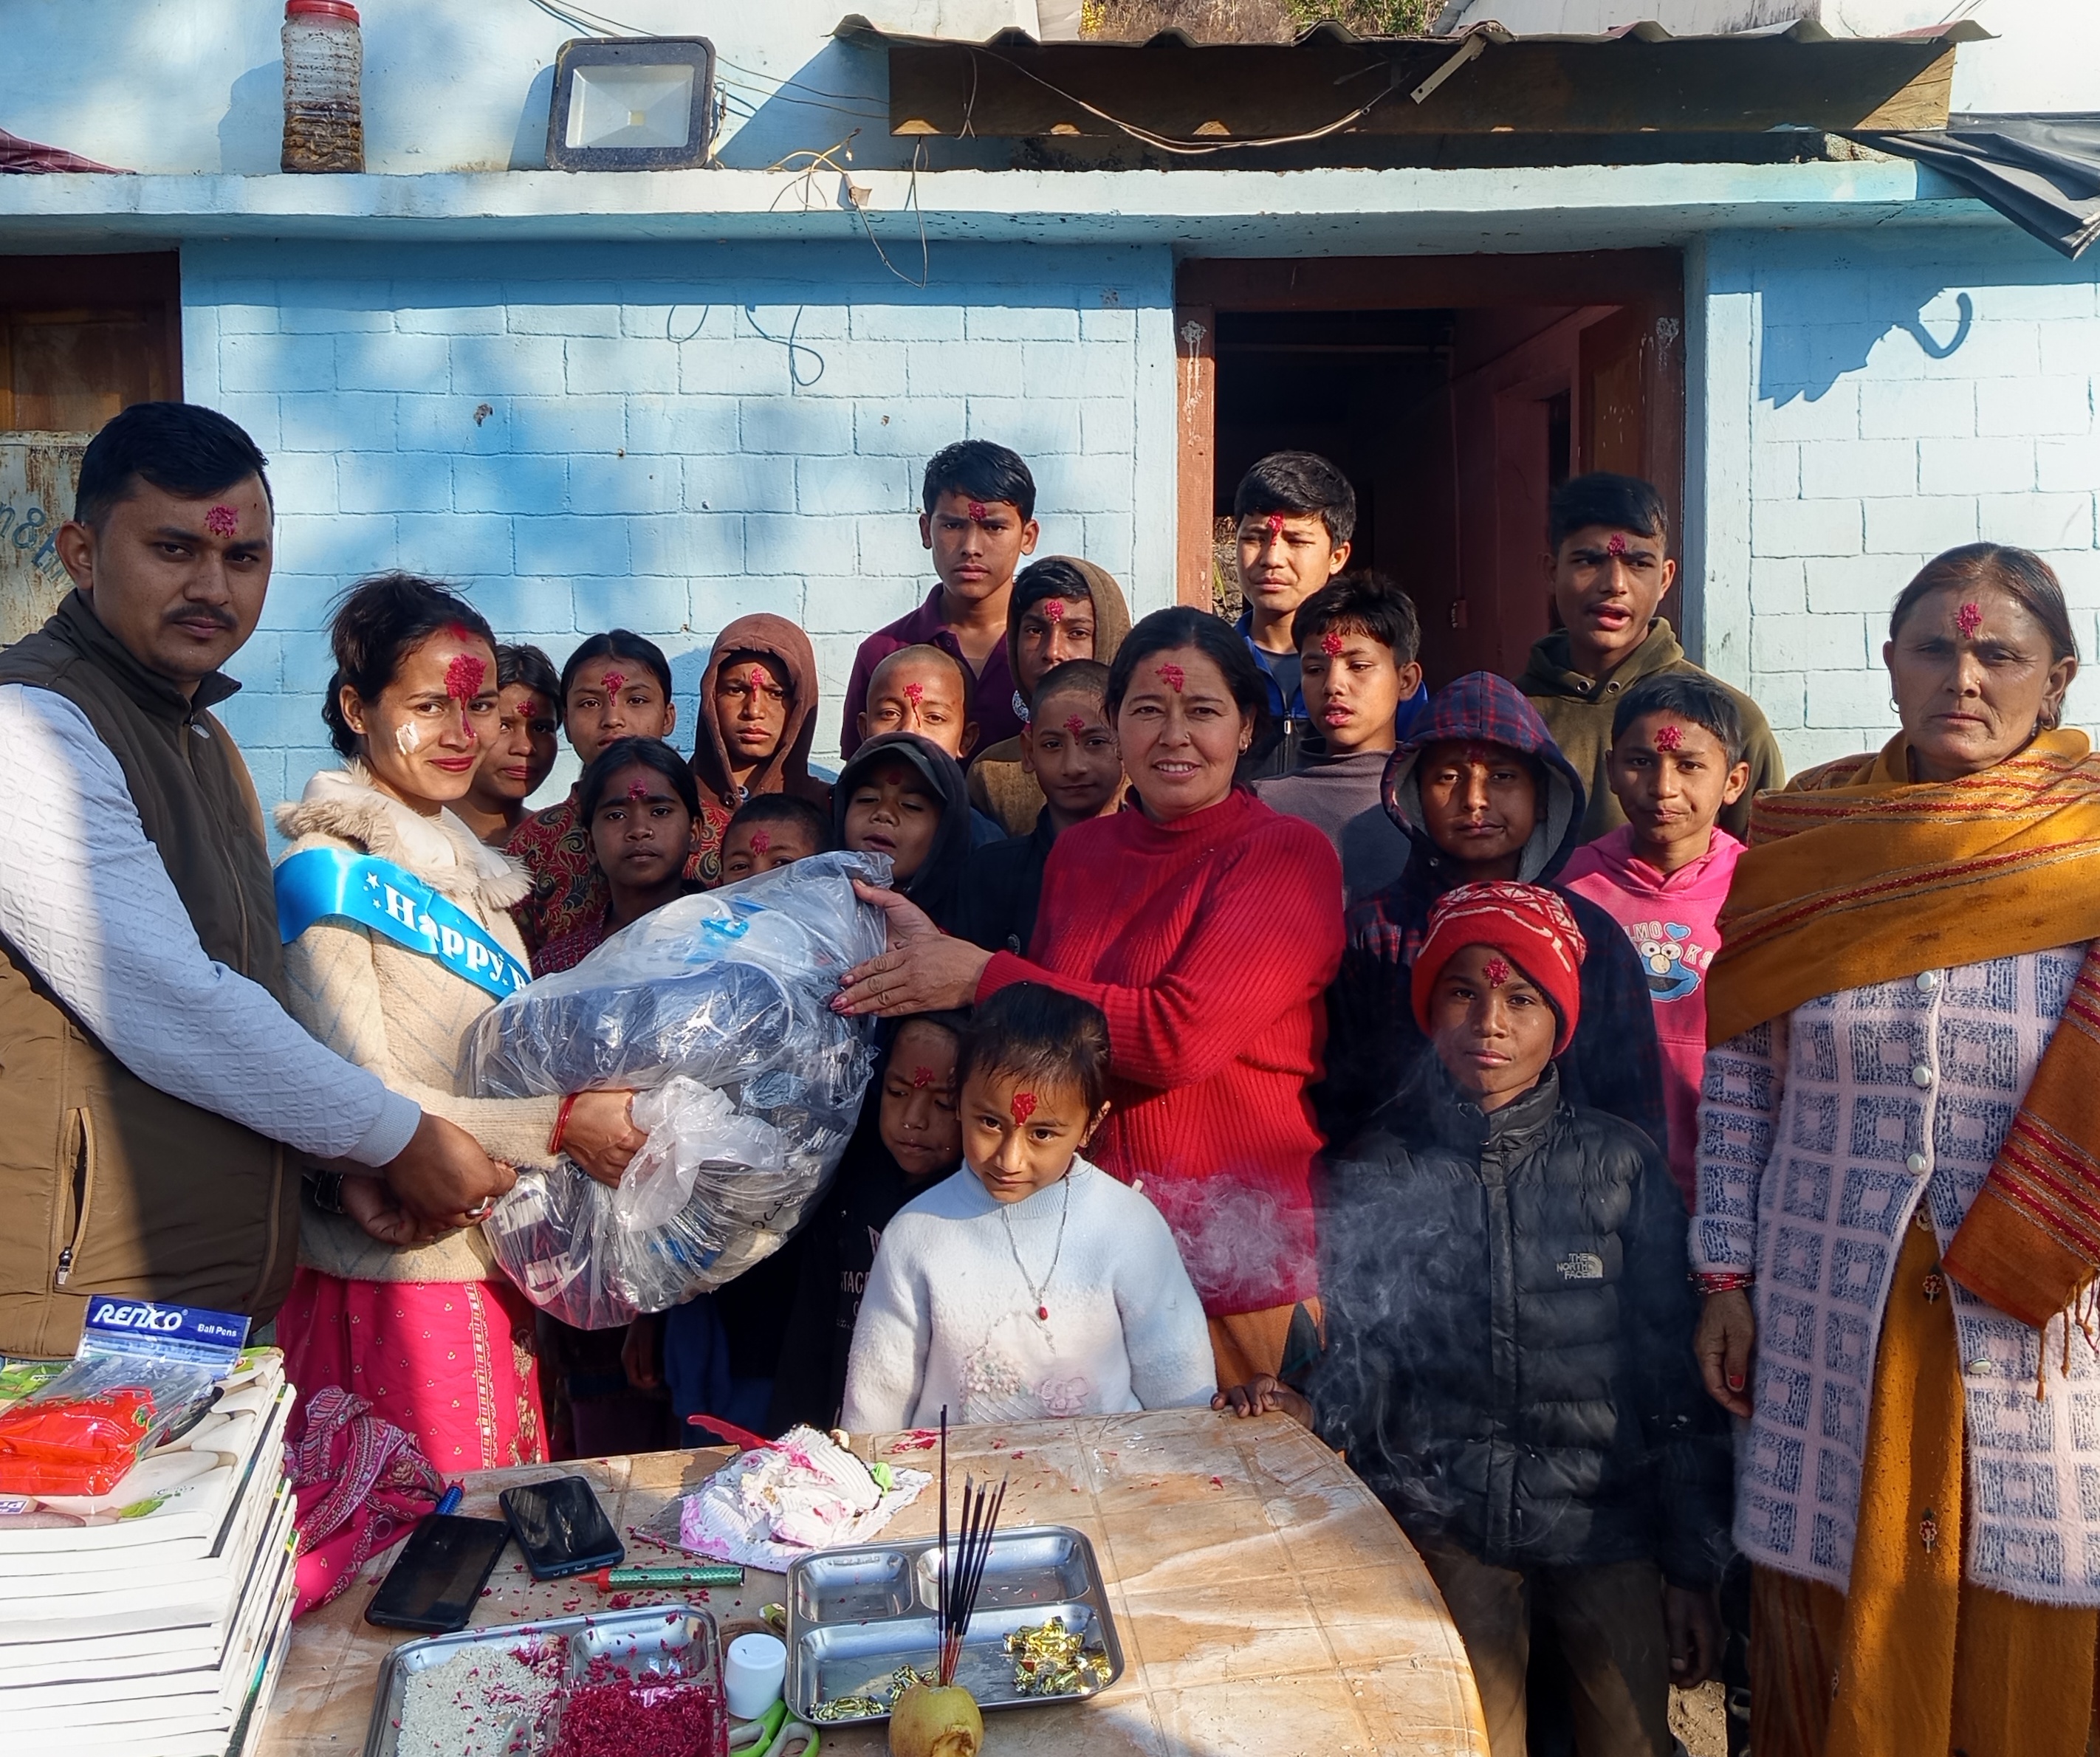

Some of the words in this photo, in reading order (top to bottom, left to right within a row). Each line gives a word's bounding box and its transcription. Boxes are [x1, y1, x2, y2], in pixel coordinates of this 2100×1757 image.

[384, 883, 504, 982] Happy
[1623, 921, 1663, 942] LMO
[1568, 1253, 1588, 1262] THE
[1557, 1262, 1588, 1273] NORTH
[1565, 1271, 1588, 1280] FACE
[92, 1303, 183, 1331] RENKO
[197, 1324, 215, 1334] Ball
[216, 1326, 237, 1337] Pens
